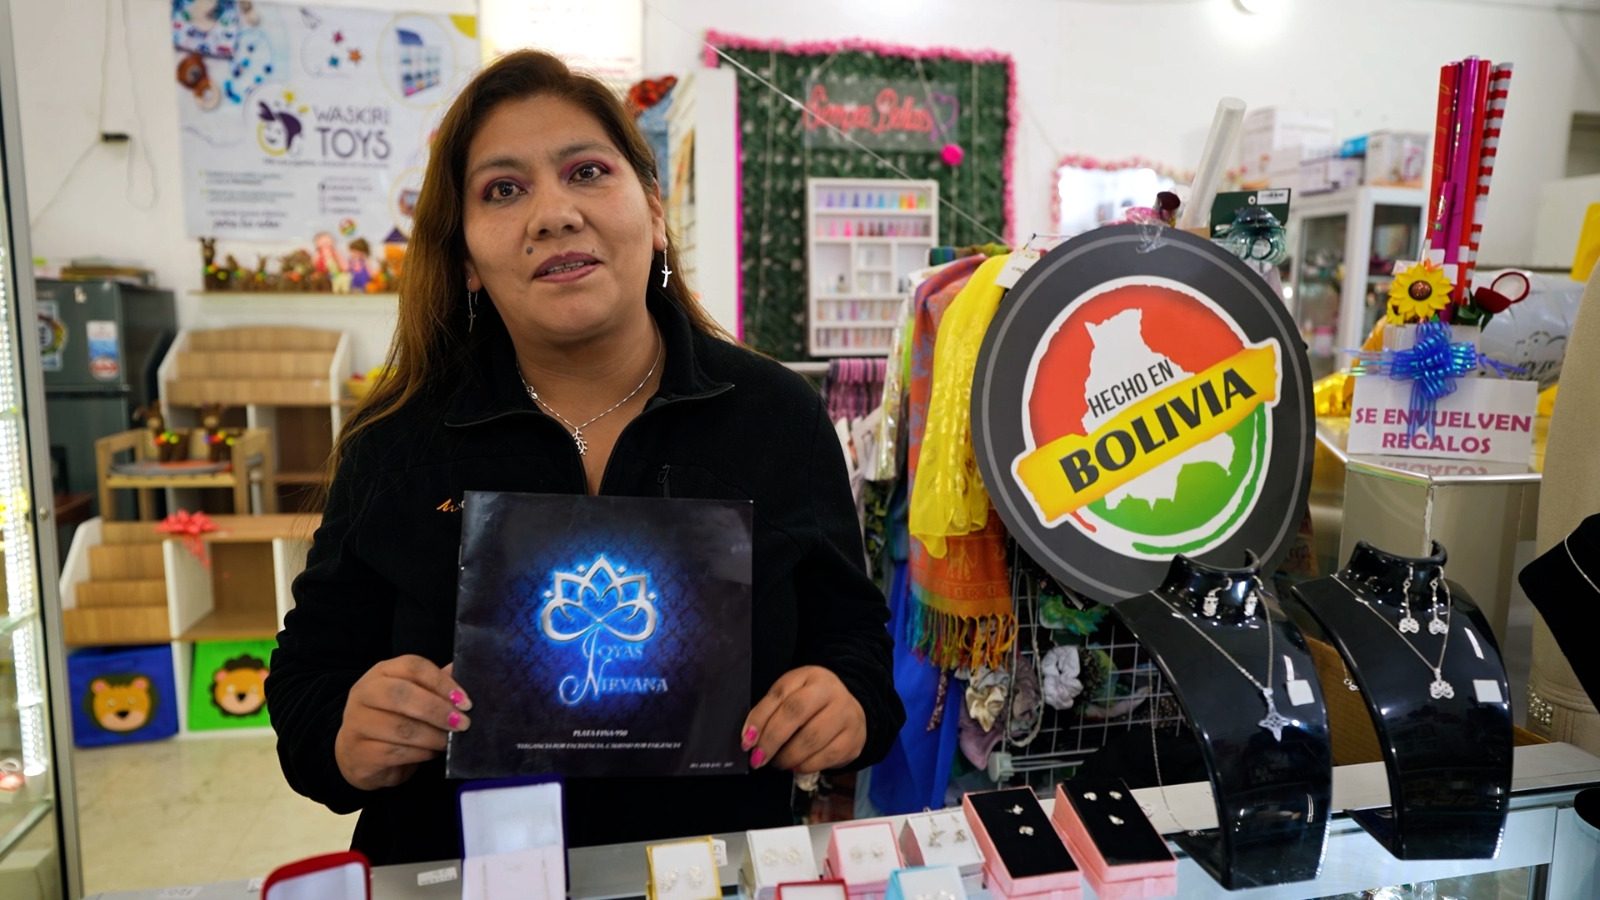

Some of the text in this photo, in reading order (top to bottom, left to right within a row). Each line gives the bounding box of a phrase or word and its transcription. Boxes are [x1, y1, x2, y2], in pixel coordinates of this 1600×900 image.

[312, 105, 389, 124] WASKIRI
[315, 127, 391, 159] TOYS
[1088, 359, 1175, 418] HECHO EN
[1058, 368, 1257, 494] BOLIVIA
[1355, 408, 1531, 432] SE ENVUELVEN
[1382, 433, 1490, 454] REGALOS
[581, 627, 644, 668] JOYAS
[558, 660, 669, 705] NIRVANA
